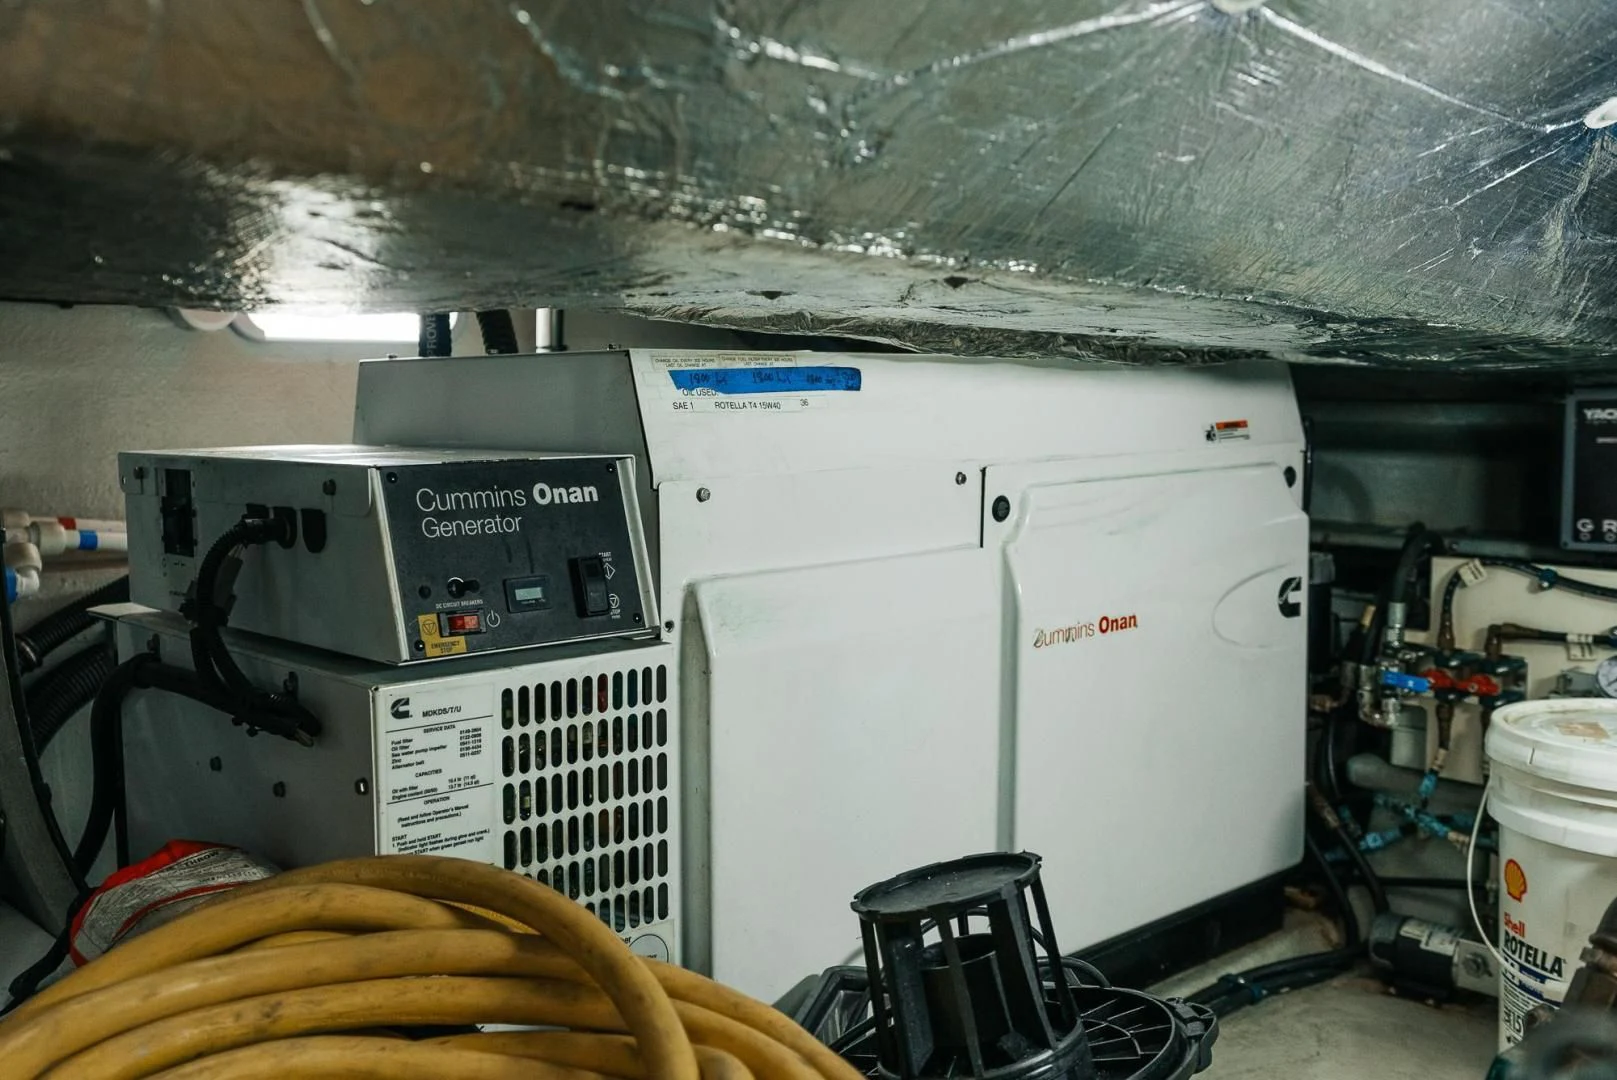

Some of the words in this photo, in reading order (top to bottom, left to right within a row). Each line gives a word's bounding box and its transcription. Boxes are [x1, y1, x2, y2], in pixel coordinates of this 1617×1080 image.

[715, 401, 747, 409] ROTELLA
[759, 401, 781, 410] 15W40
[416, 485, 526, 512] Cummins
[532, 482, 599, 505] Onan
[421, 515, 522, 538] Generator
[1033, 621, 1095, 648] Cummins
[1099, 614, 1138, 634] Onan
[1504, 912, 1525, 938] Shell
[1504, 930, 1563, 978] ROTELLA
